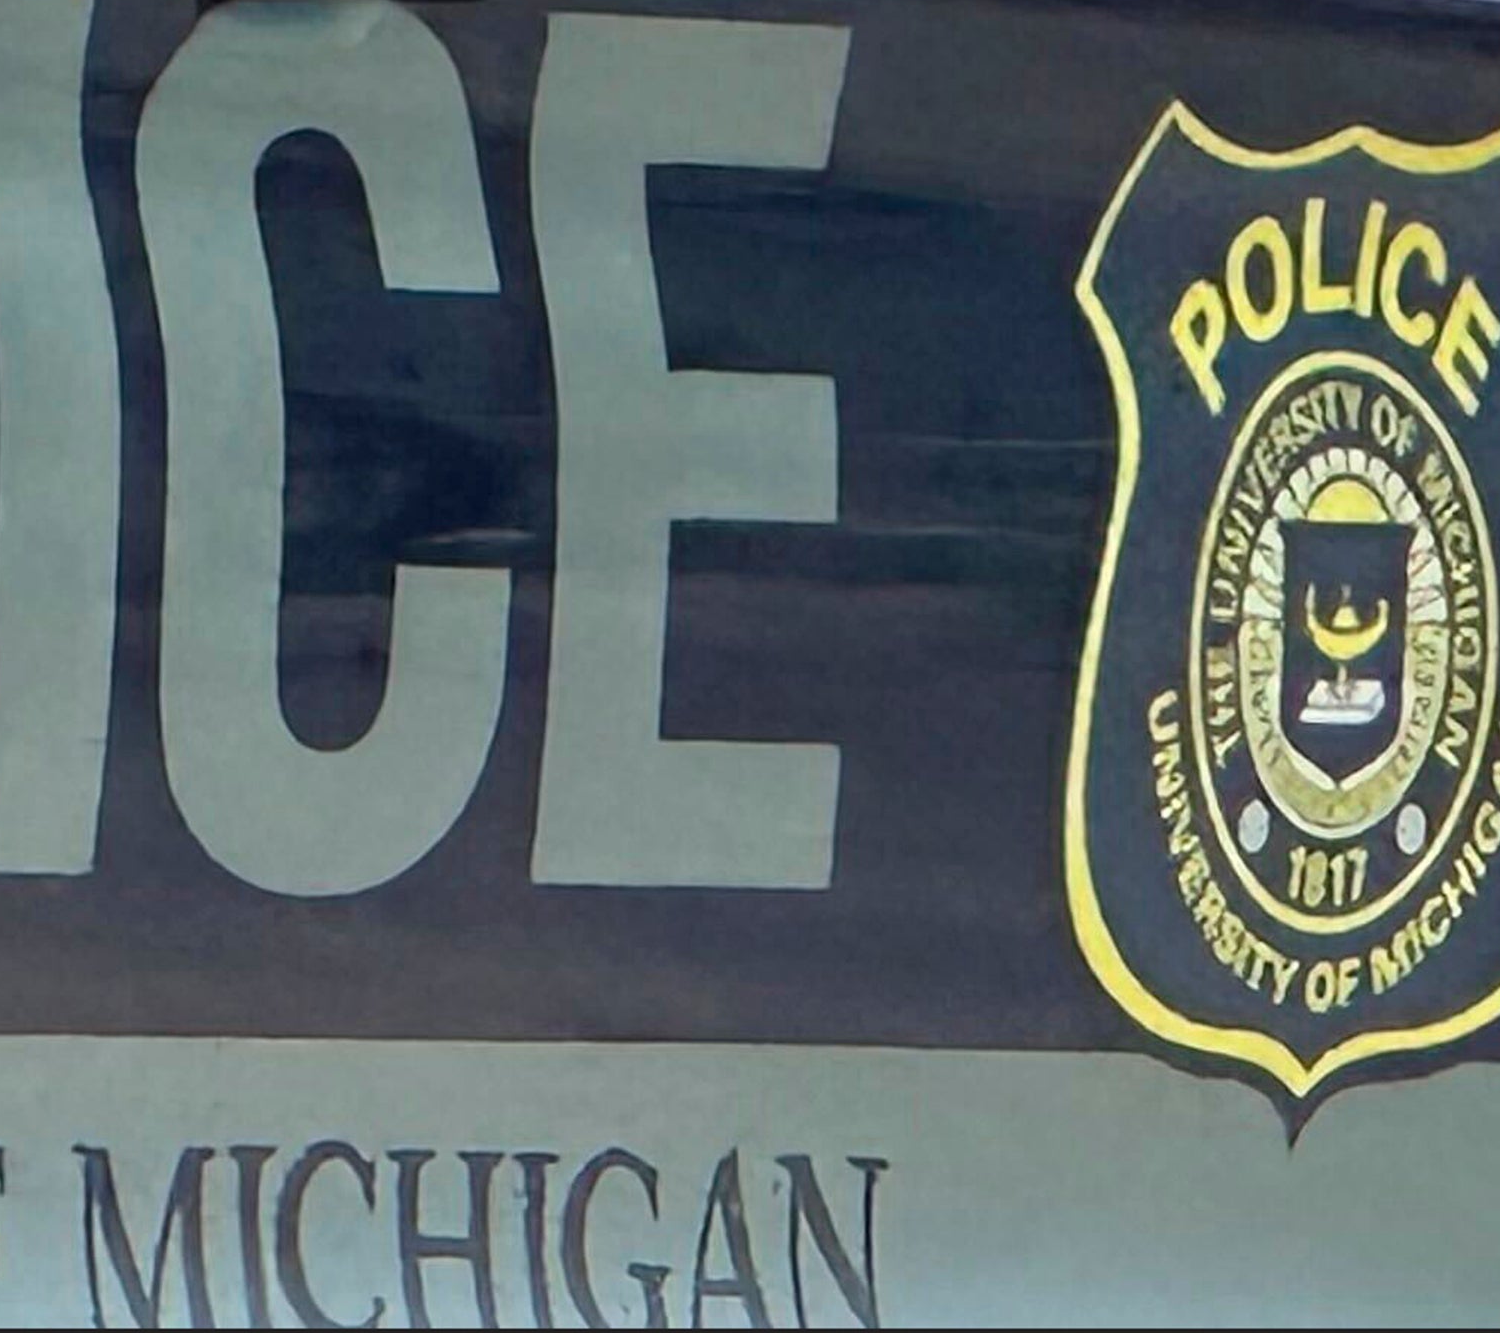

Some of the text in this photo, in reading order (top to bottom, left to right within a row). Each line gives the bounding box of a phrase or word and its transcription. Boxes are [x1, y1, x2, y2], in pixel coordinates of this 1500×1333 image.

[1209, 380, 1363, 623] UNIVERSITY
[1371, 393, 1418, 457] OF
[1148, 689, 1299, 1006] UNIVERSITY
[1305, 957, 1361, 1013] OF
[1288, 845, 1369, 907] 1817
[72, 1139, 890, 1329] MICHIGAN
